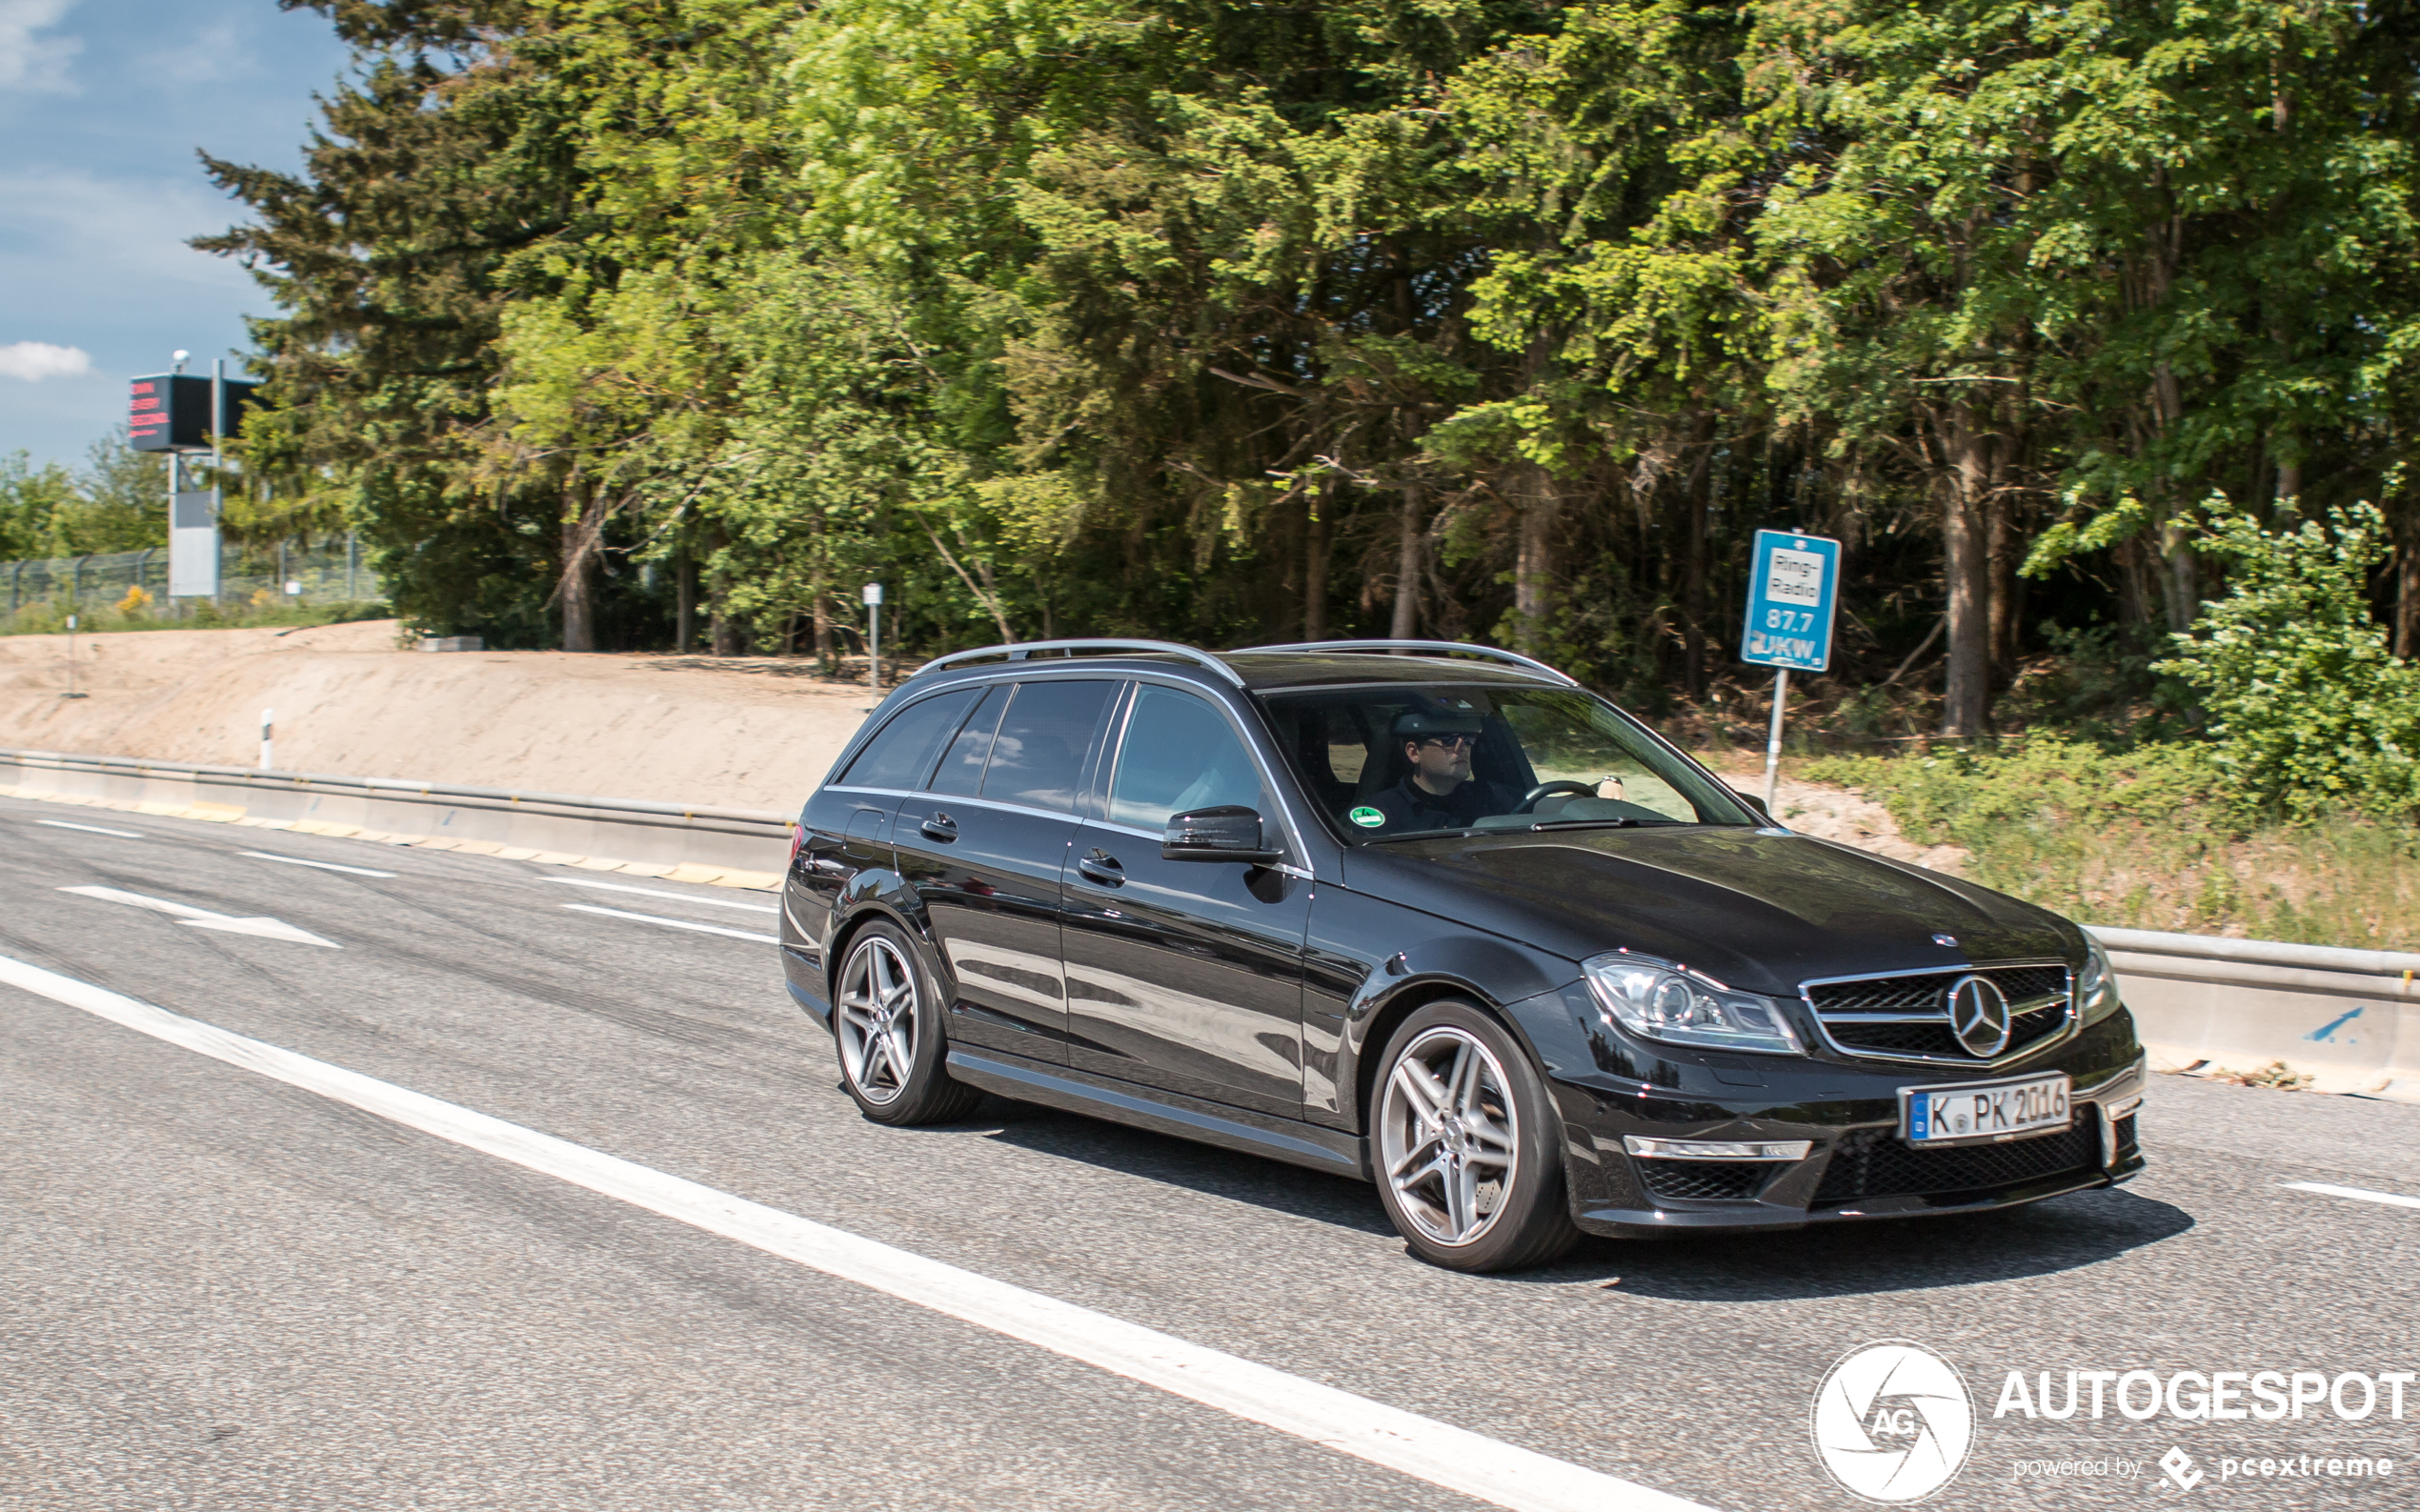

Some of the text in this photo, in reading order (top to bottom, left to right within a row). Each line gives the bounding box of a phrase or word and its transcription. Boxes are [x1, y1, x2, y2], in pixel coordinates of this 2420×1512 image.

[1774, 554, 1819, 577] Ring-
[1769, 577, 1818, 598] Radio
[1765, 608, 1815, 633] 87.7
[1361, 808, 1371, 816] 4
[1931, 1082, 2066, 1134] K PK 2016
